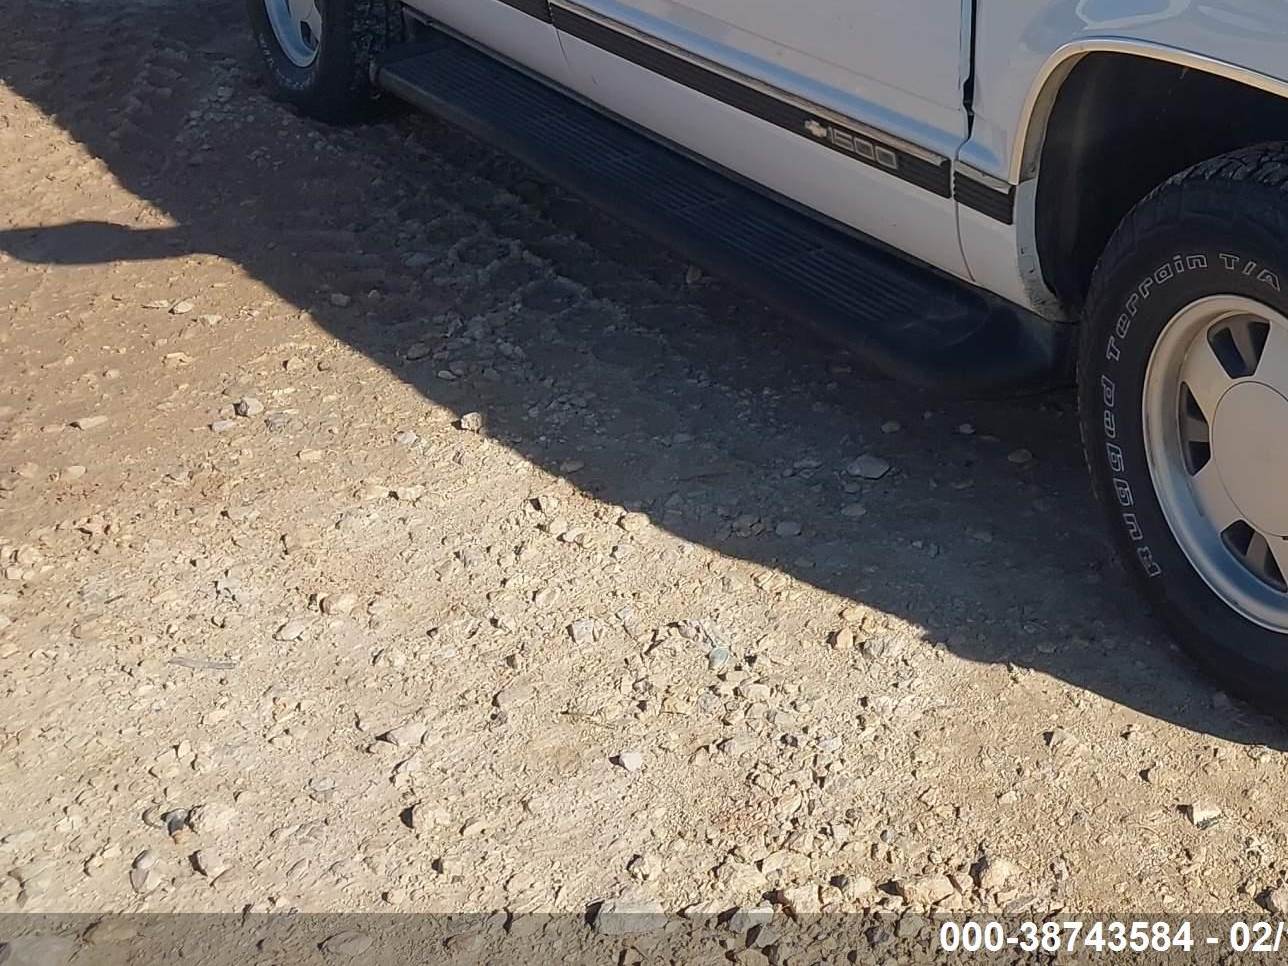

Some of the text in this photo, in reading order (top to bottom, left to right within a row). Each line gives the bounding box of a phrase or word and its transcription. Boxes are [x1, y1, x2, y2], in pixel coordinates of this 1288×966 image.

[828, 126, 898, 171] 1500
[1105, 254, 1208, 362] Terrain
[1101, 375, 1162, 577] Rugged
